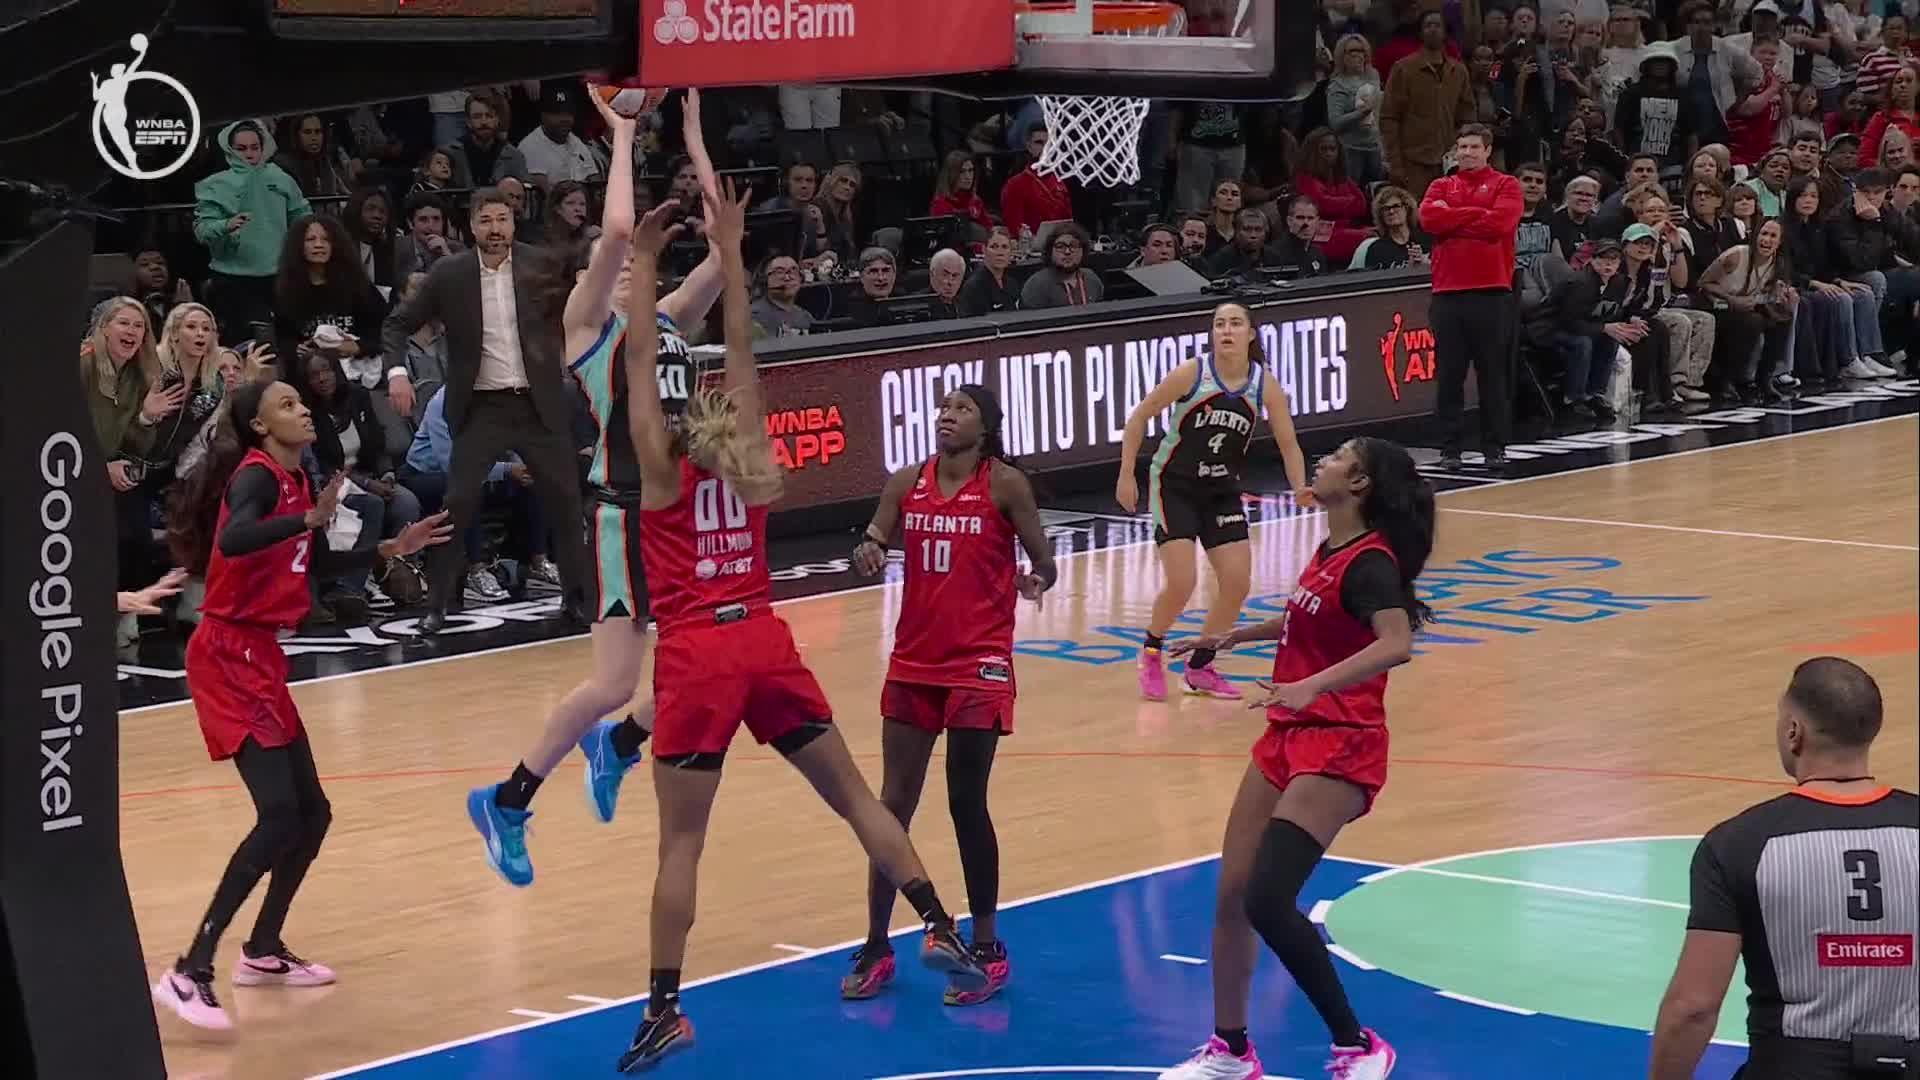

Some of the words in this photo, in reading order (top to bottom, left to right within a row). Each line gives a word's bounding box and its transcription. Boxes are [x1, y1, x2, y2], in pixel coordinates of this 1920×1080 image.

[766, 405, 844, 436] WNBA
[999, 350, 1075, 457] INTO
[772, 431, 847, 468] APP
[1208, 432, 1227, 454] 4
[905, 512, 982, 535] ATLANTA
[29, 431, 83, 670] Google
[291, 540, 308, 573] 2
[718, 556, 754, 577] AT&T
[921, 538, 952, 574] 10
[40, 683, 83, 832] Pixel
[1843, 849, 1884, 921] 3
[1826, 941, 1905, 958] Emirates
